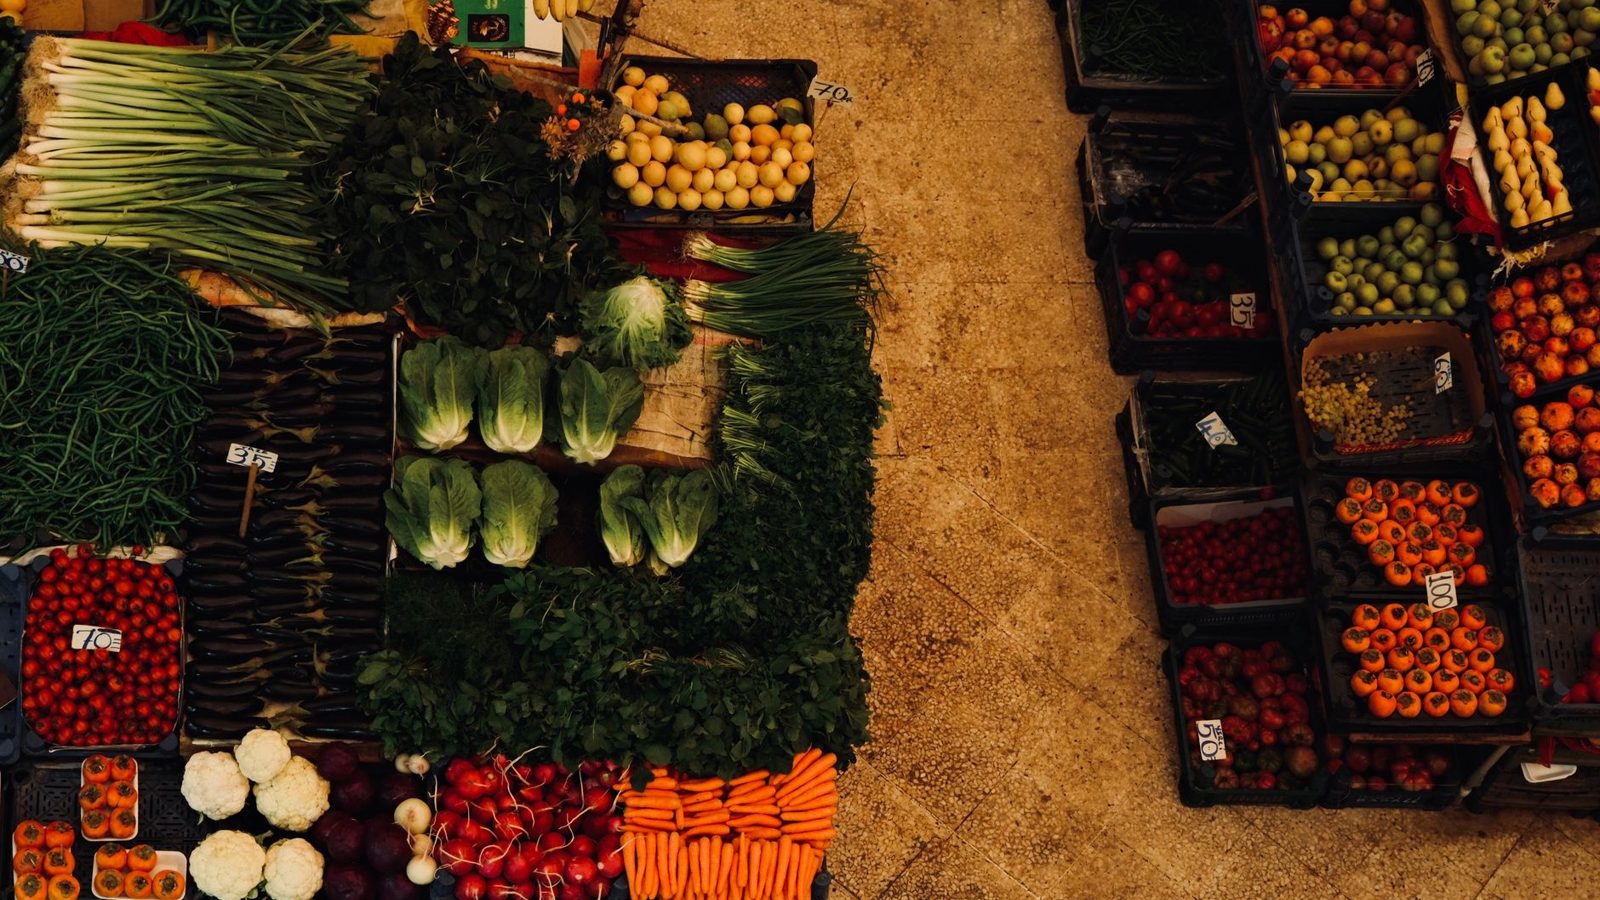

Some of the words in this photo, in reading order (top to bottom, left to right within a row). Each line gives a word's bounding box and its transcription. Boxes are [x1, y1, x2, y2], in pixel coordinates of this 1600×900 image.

[814, 81, 848, 101] 70
[1232, 296, 1252, 325] 35
[1435, 359, 1450, 389] 60
[1198, 418, 1227, 447] 40
[228, 448, 272, 469] 35
[1429, 576, 1453, 609] 100
[76, 628, 112, 649] 70
[1198, 724, 1218, 757] 50
